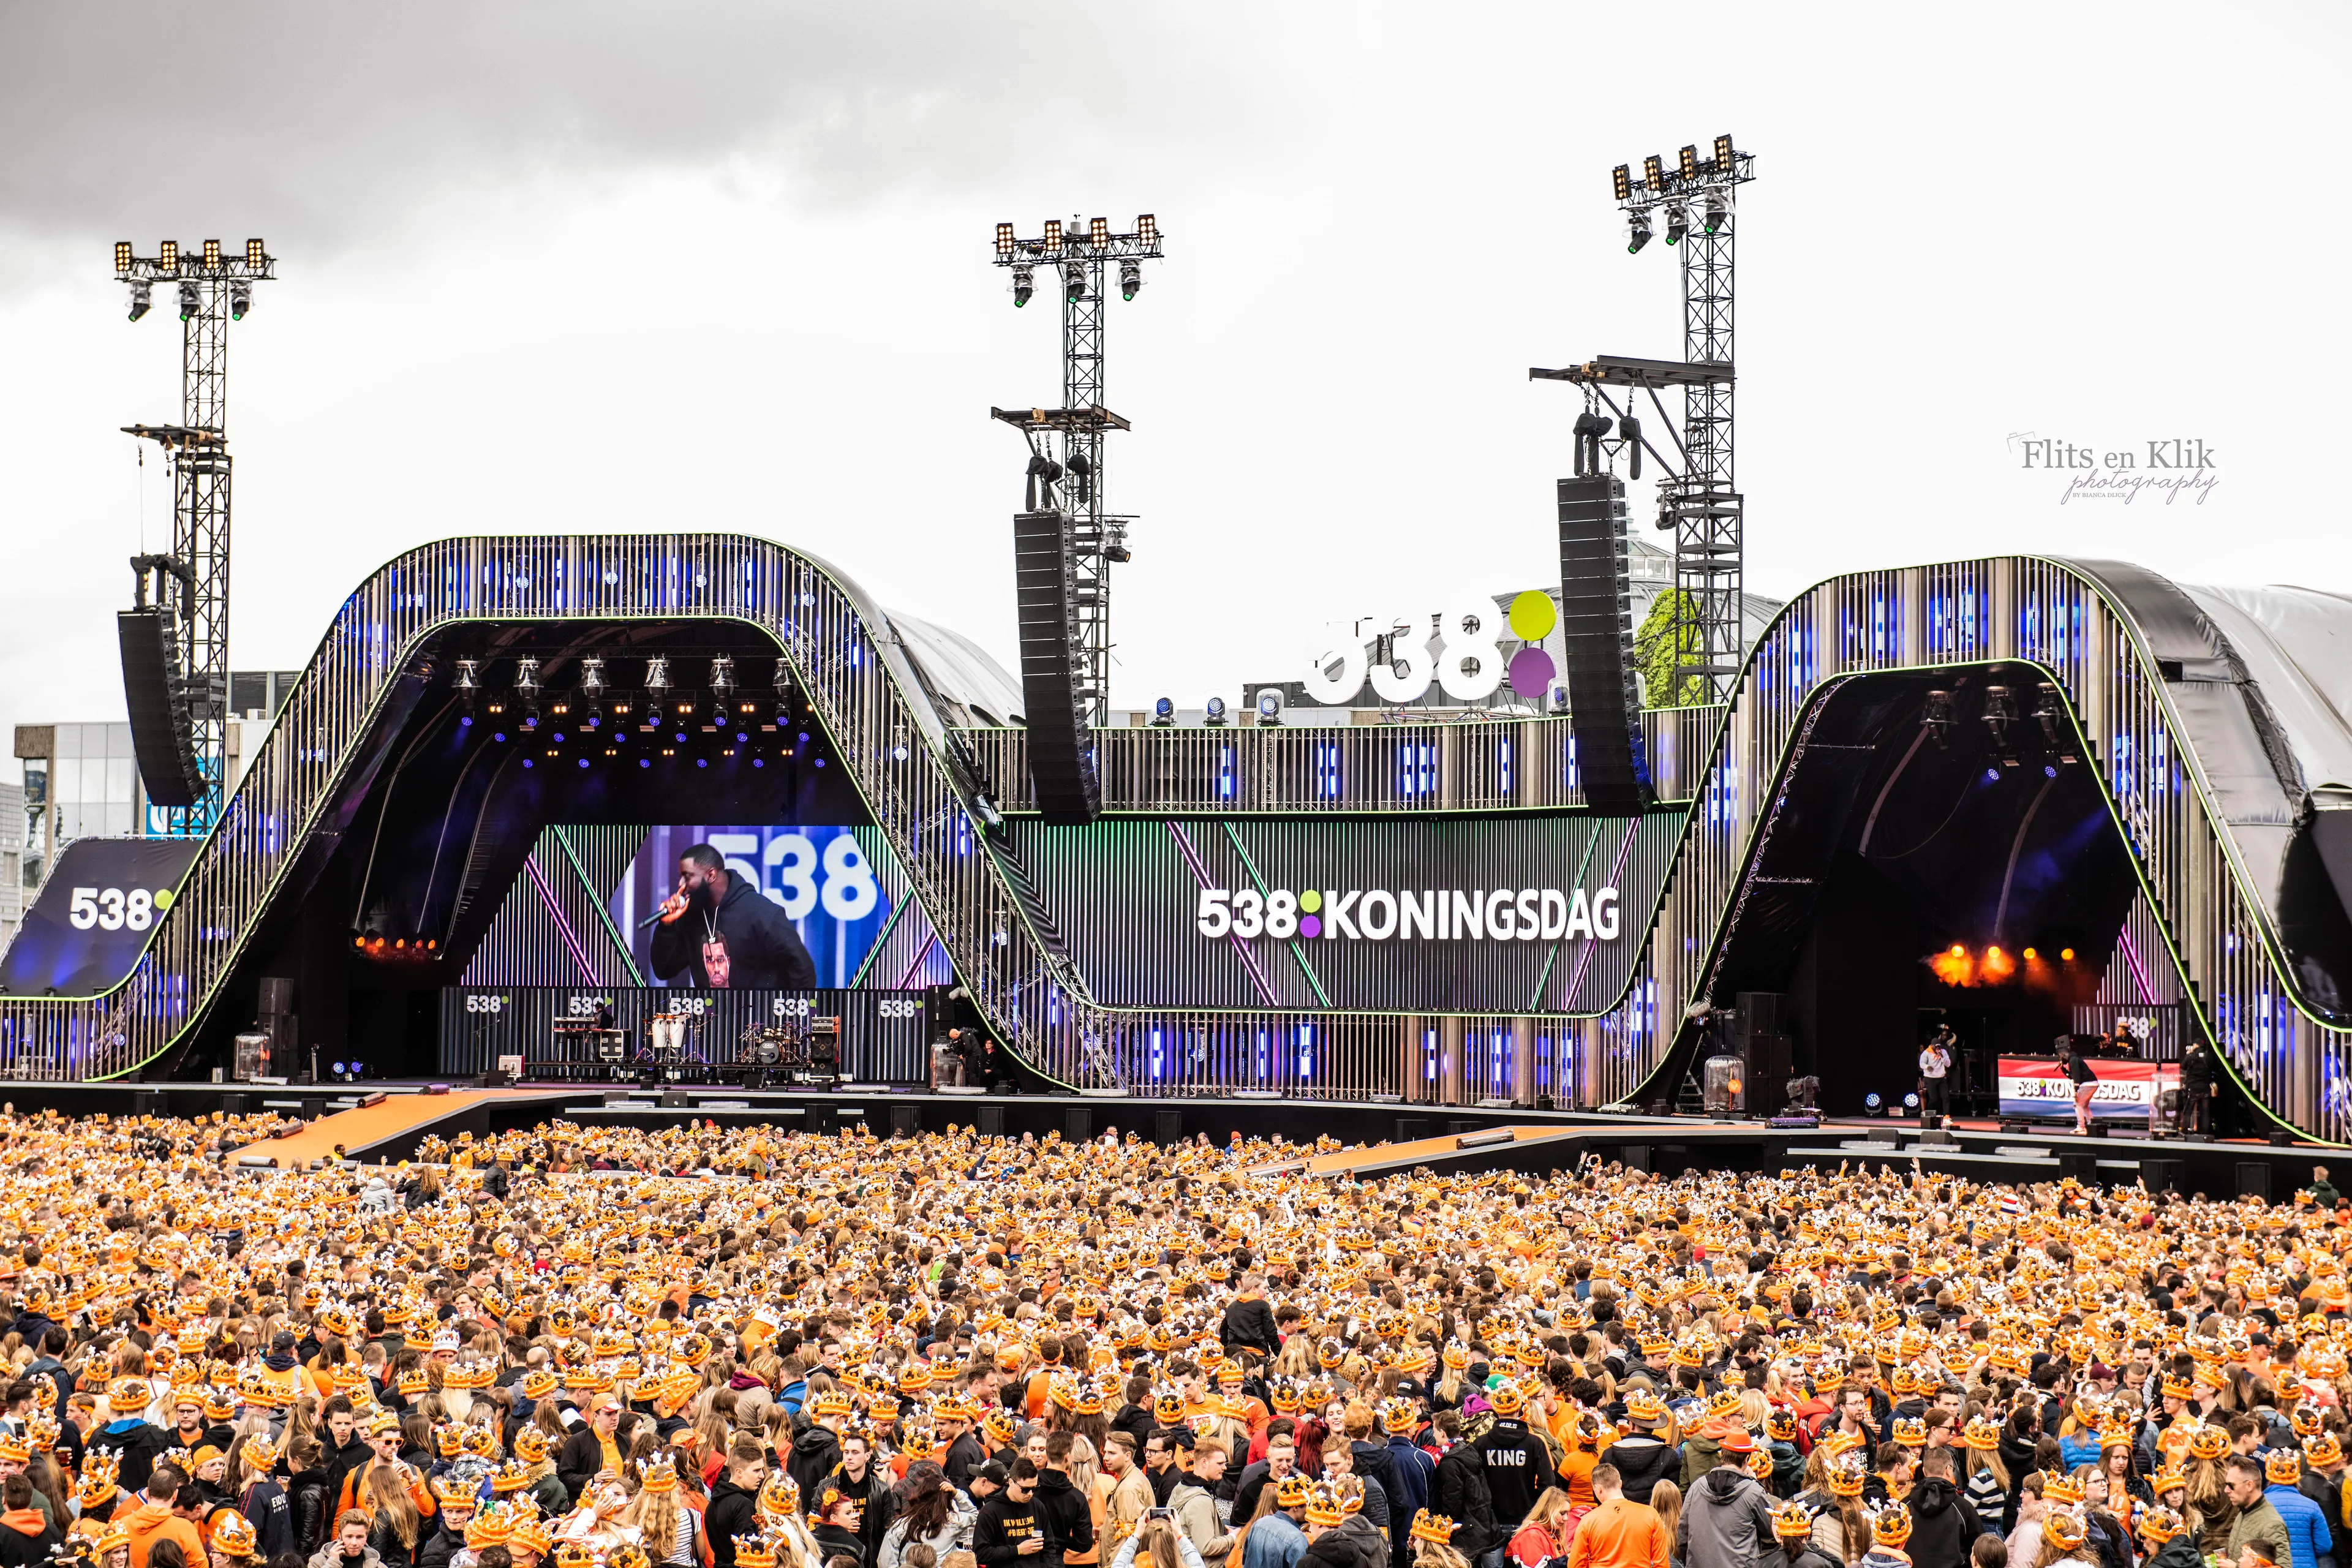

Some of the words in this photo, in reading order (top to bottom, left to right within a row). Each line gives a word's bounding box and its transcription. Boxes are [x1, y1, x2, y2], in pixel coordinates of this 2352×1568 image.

[1302, 594, 1504, 704] 538
[70, 887, 153, 931] 538
[467, 995, 501, 1013] 538
[669, 998, 704, 1016] 538
[773, 998, 809, 1017] 538
[880, 1000, 915, 1017] 538
[1487, 1449, 1526, 1466] KING
